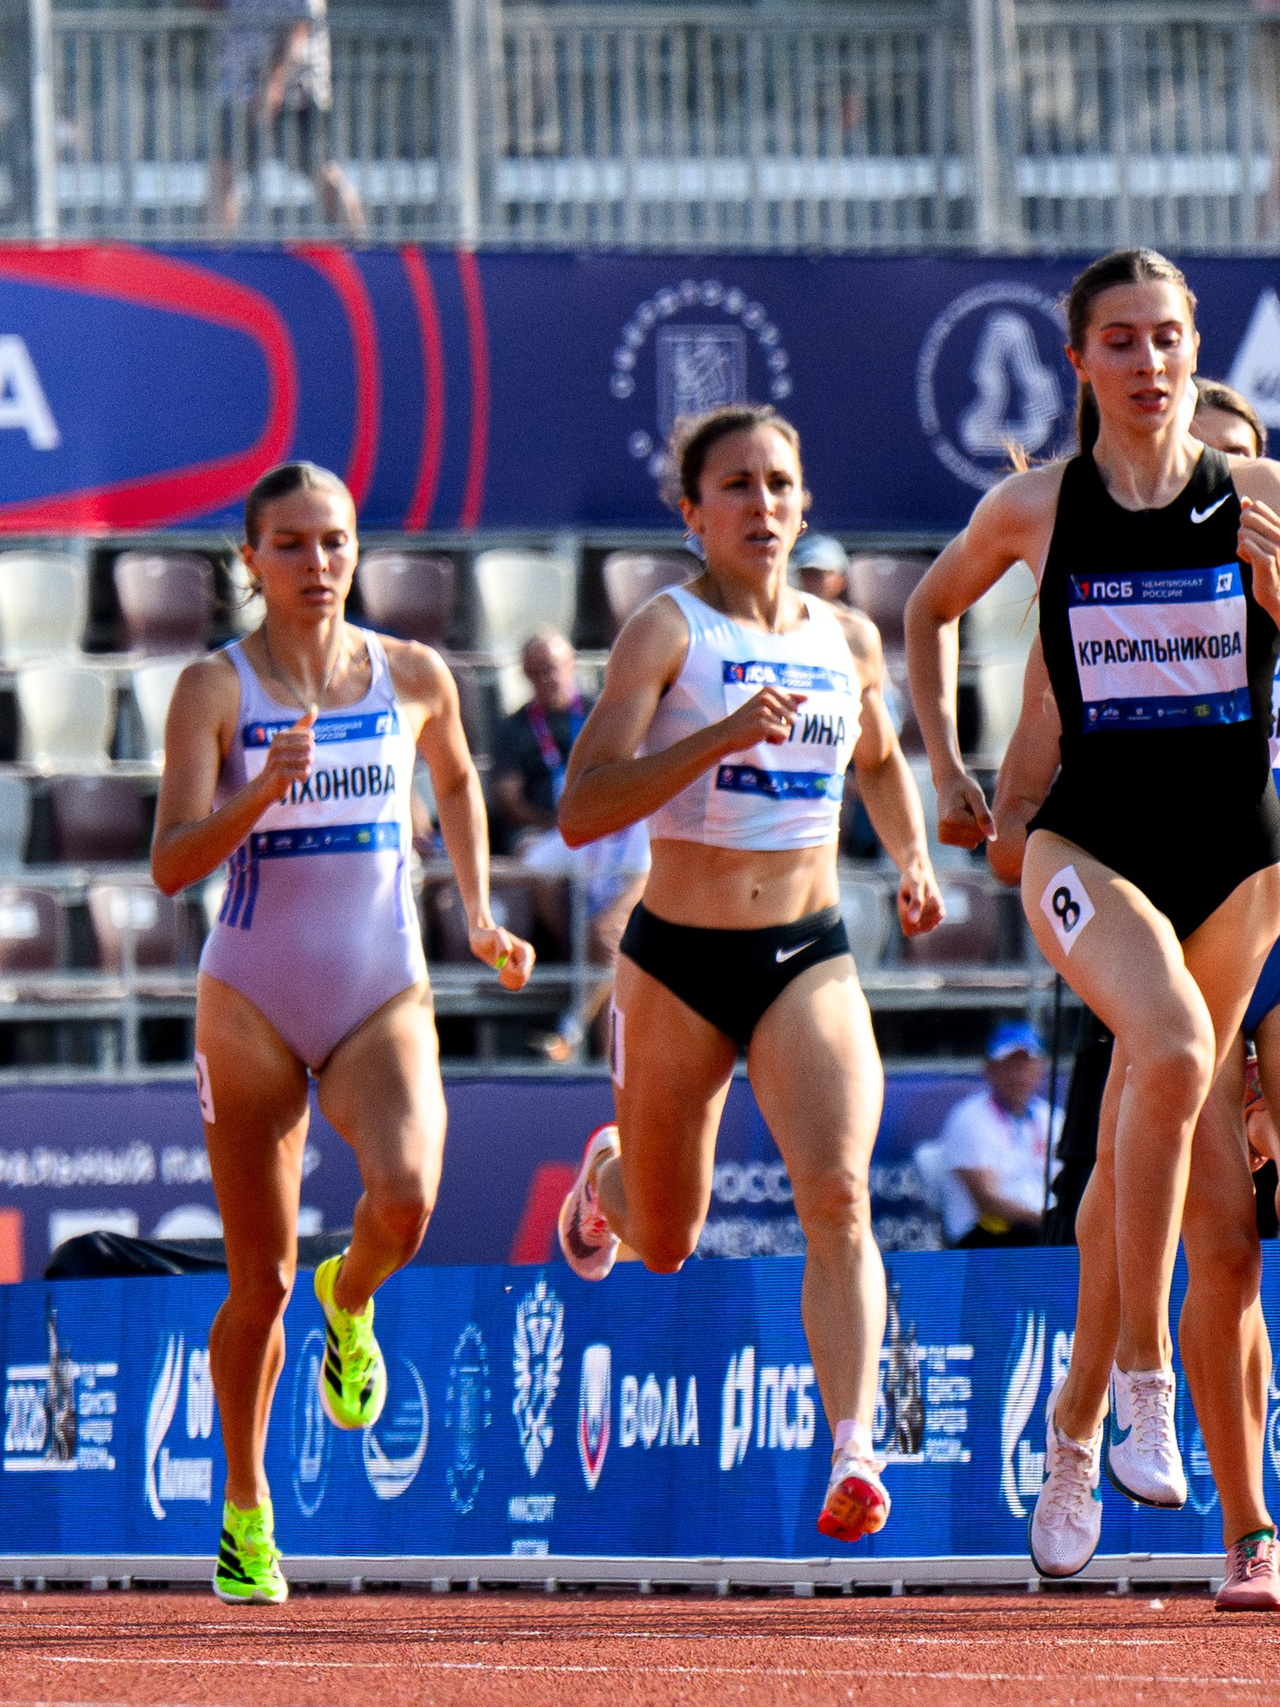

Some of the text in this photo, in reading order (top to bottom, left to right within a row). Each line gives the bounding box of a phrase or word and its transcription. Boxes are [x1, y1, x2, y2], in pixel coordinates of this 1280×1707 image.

[1093, 581, 1133, 599] ПСБ
[1078, 631, 1242, 667] КРАСИЛЬНИКОВА
[1052, 886, 1081, 933] 8
[756, 1363, 816, 1451] ПСБ
